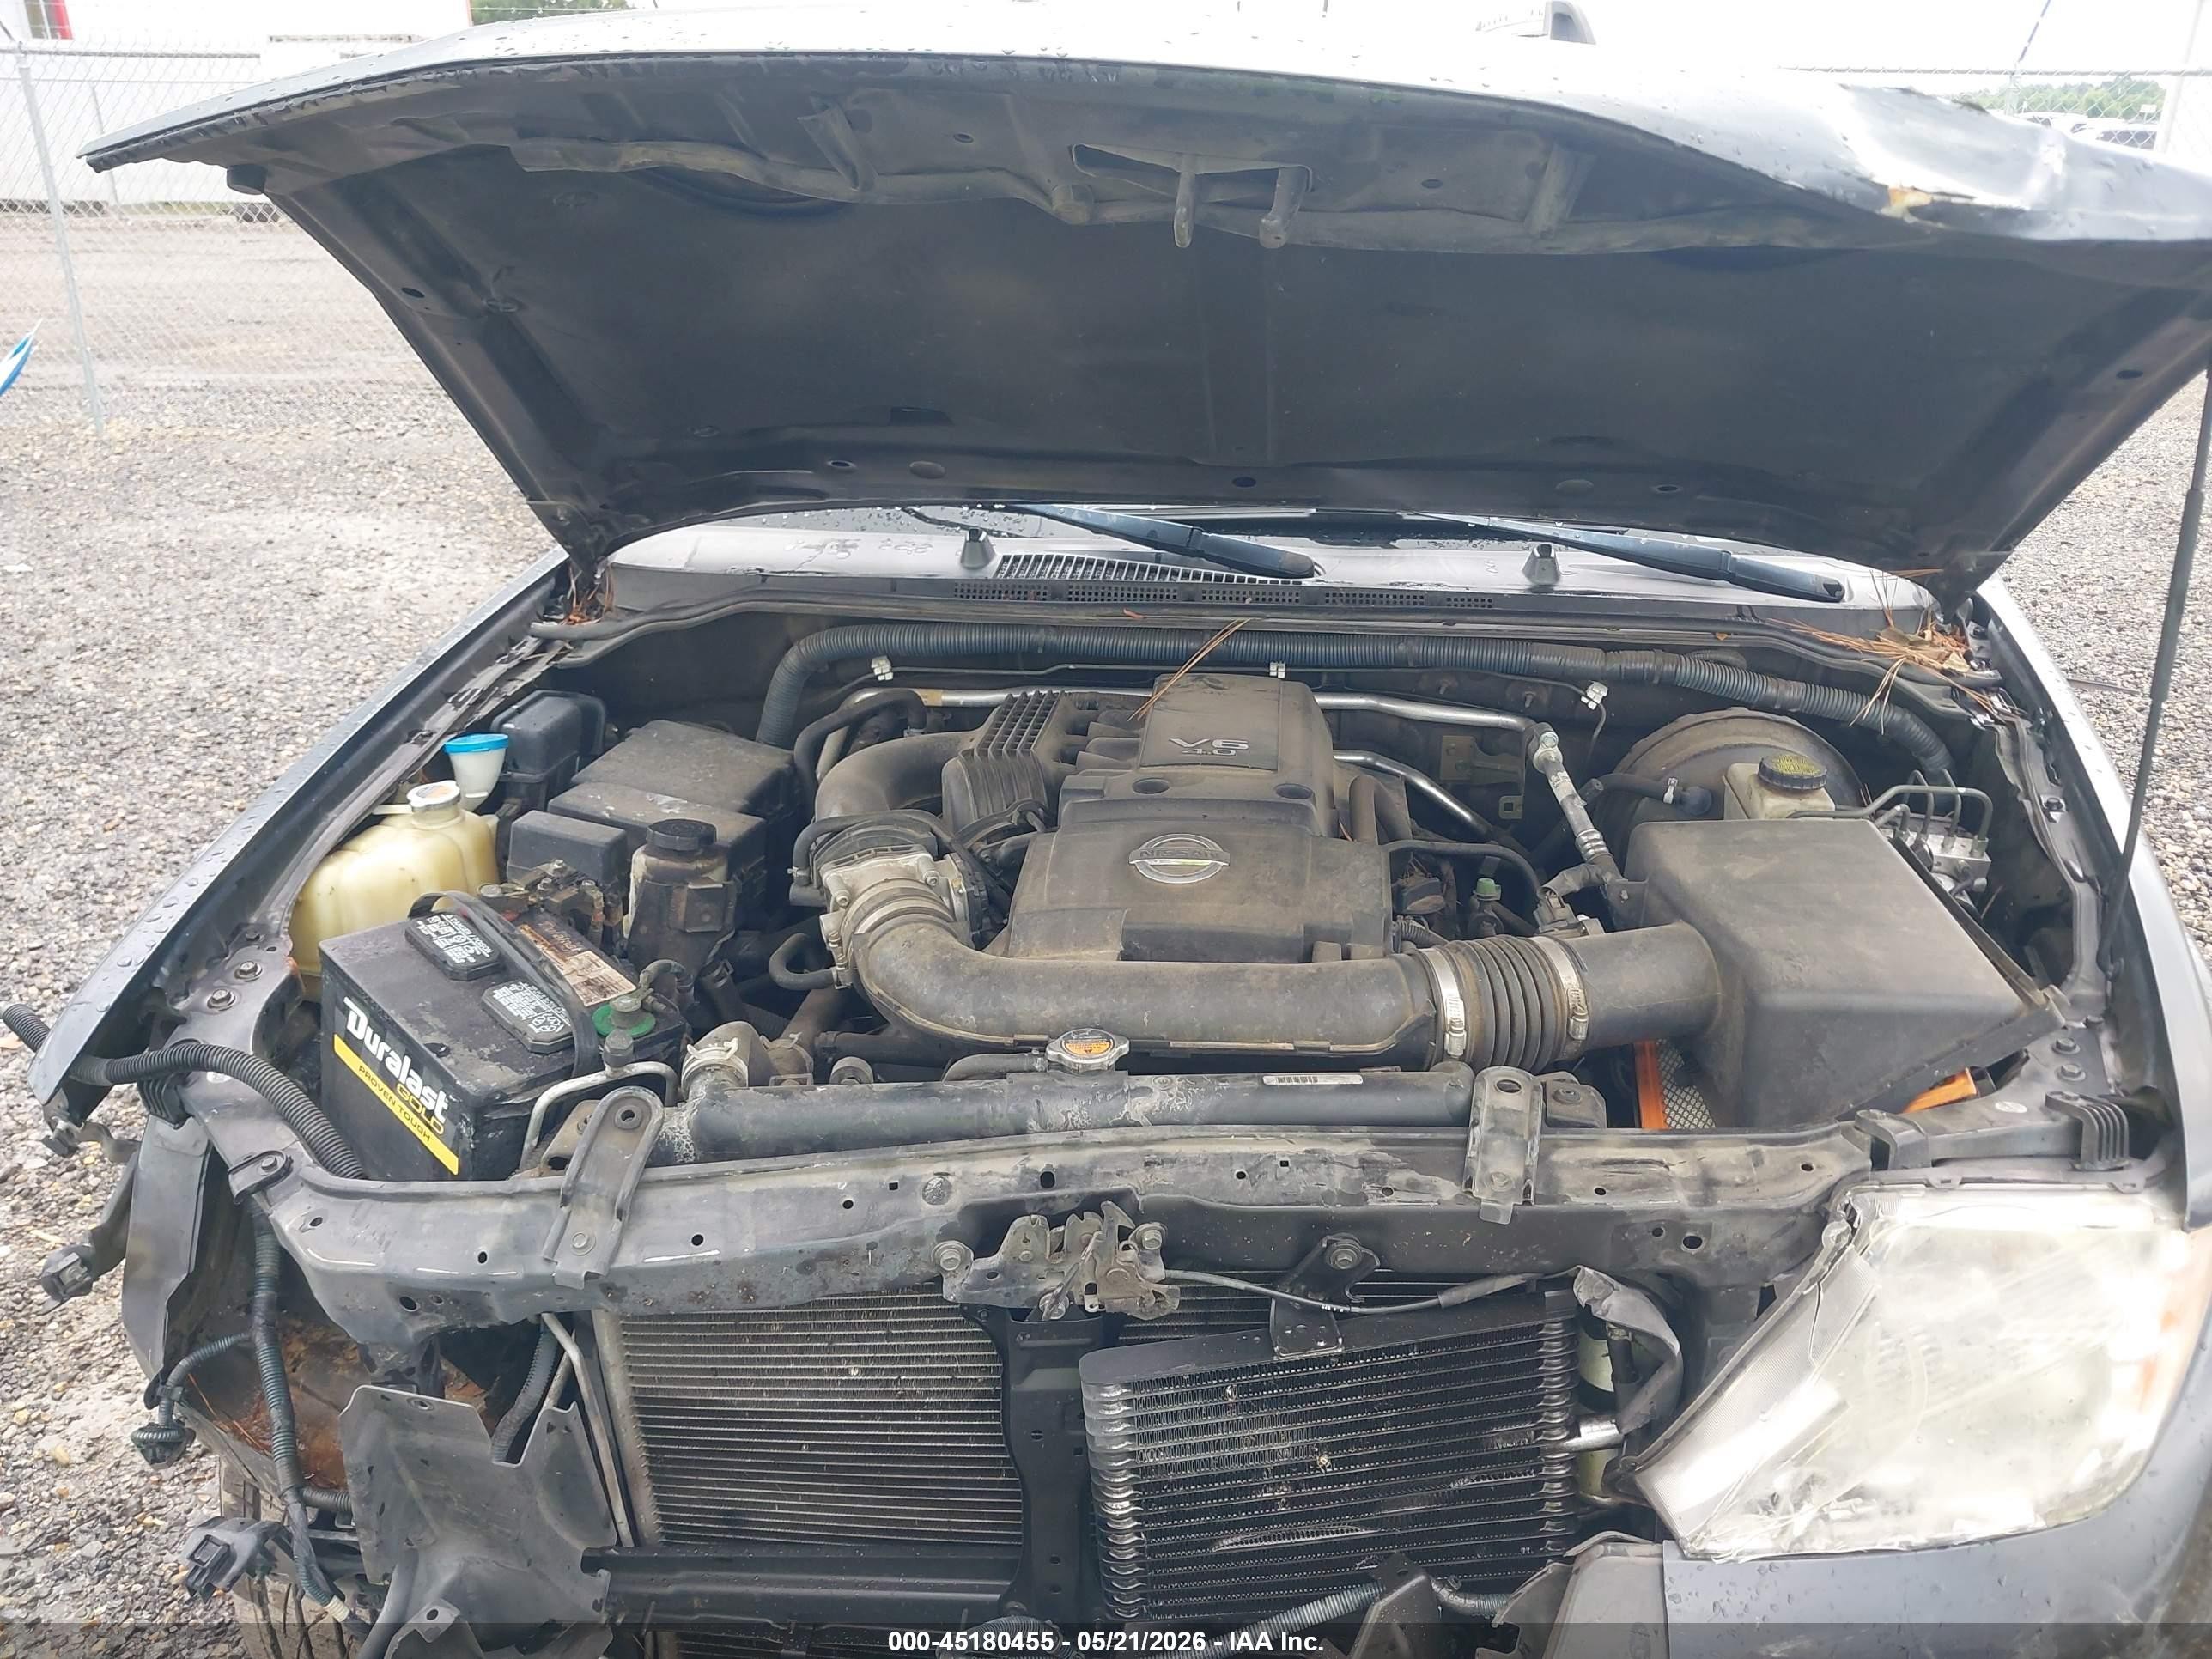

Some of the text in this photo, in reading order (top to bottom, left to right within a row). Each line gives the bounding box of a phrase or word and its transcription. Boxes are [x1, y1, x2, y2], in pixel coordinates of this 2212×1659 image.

[1168, 737, 1249, 750] V6
[1139, 848, 1221, 859] NISSAN
[343, 996, 448, 1124] Duralast
[357, 1065, 431, 1141] PROVEN TOUGH
[396, 1082, 445, 1135] GOLD
